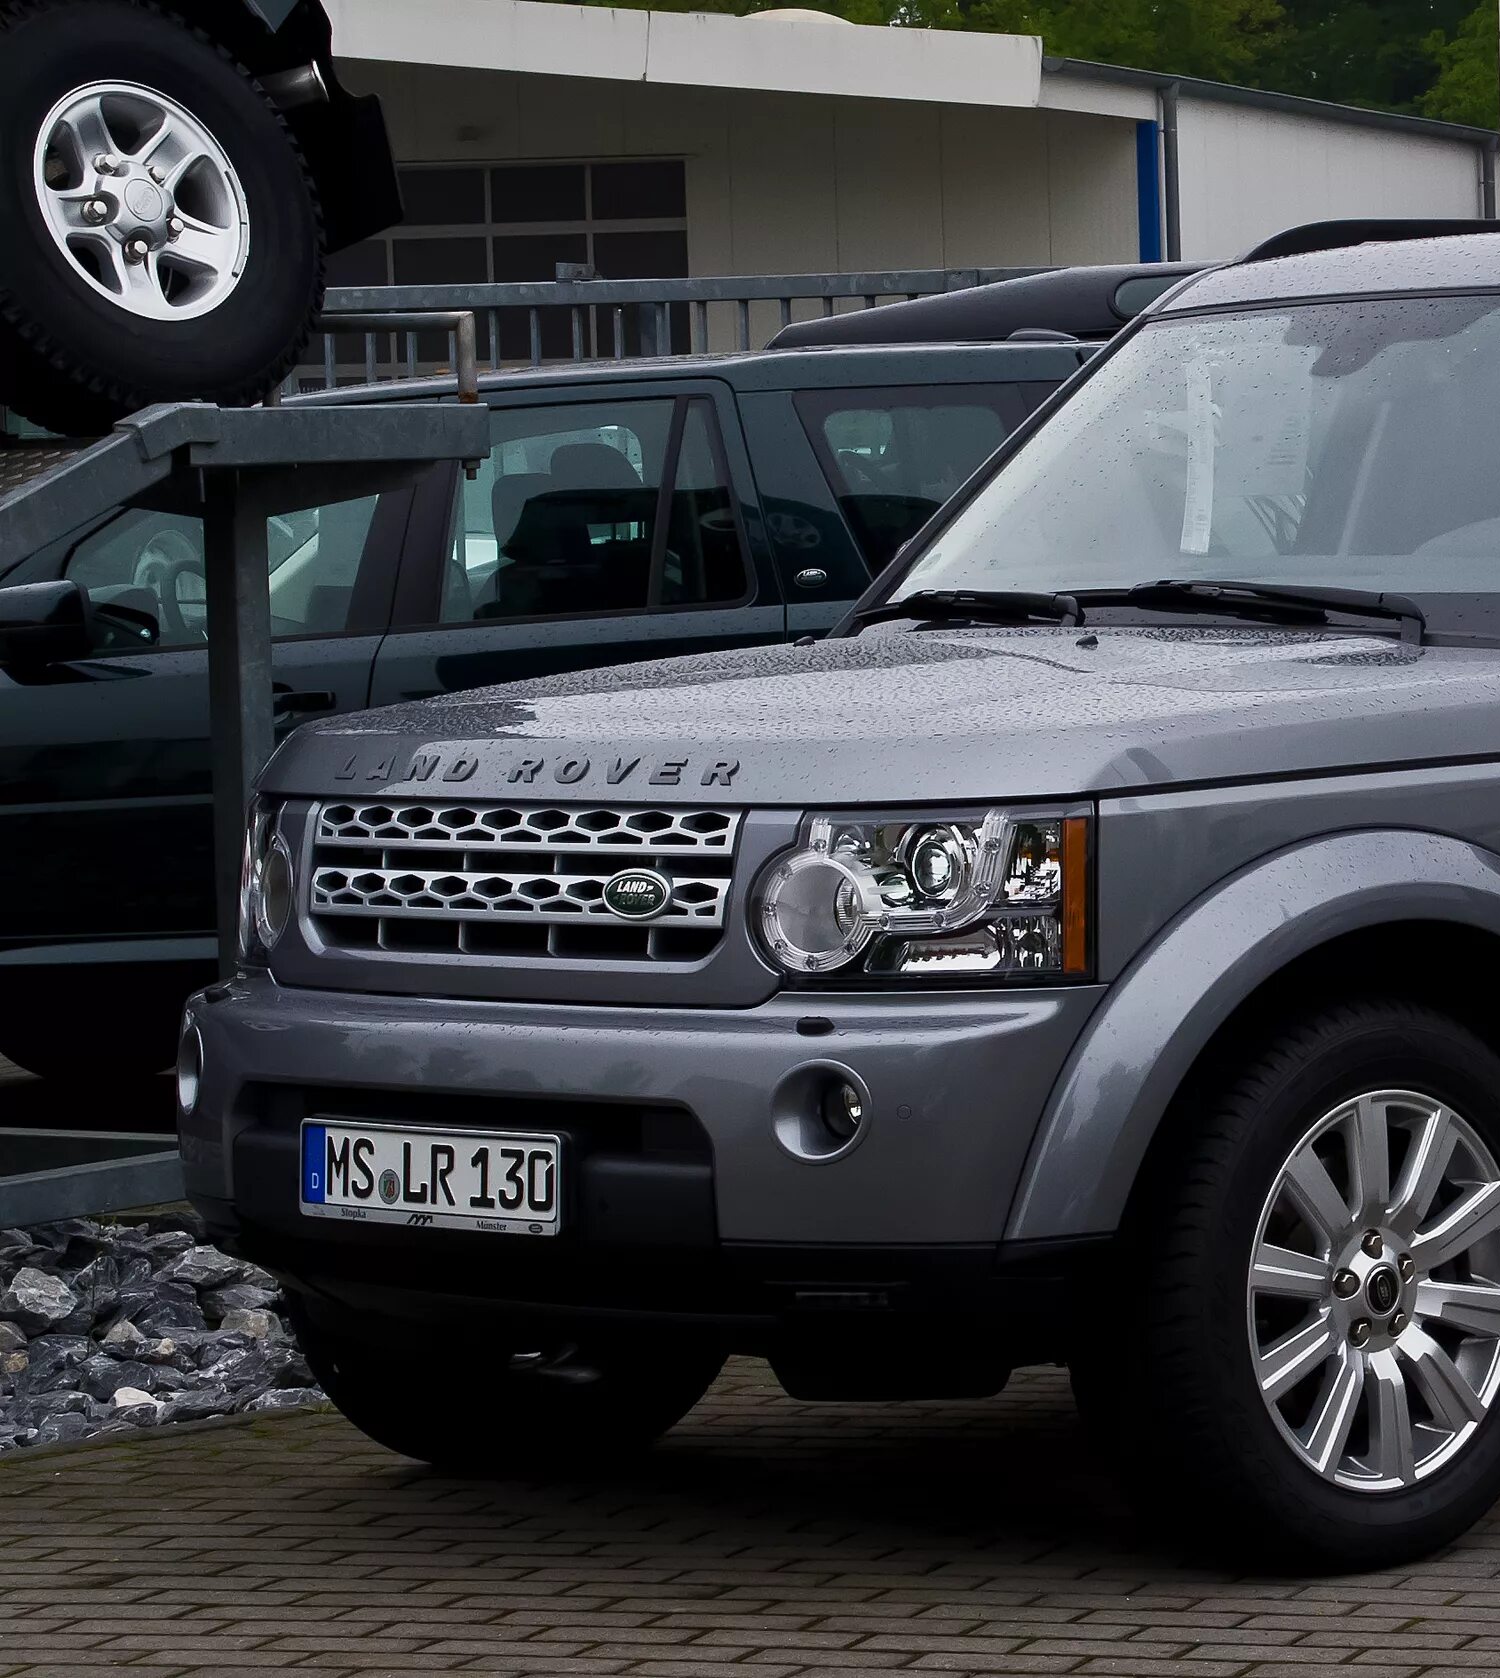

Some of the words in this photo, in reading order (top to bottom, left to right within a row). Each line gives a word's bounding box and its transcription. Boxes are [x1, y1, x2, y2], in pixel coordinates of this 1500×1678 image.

[333, 754, 479, 782] LAND
[507, 757, 742, 786] ROVER
[616, 881, 648, 893] LAND
[619, 893, 656, 906] ROVER
[311, 1172, 320, 1189] D
[327, 1135, 375, 1199] MS
[403, 1141, 456, 1206] LR
[470, 1147, 555, 1212] 130
[340, 1208, 367, 1220] Stopka
